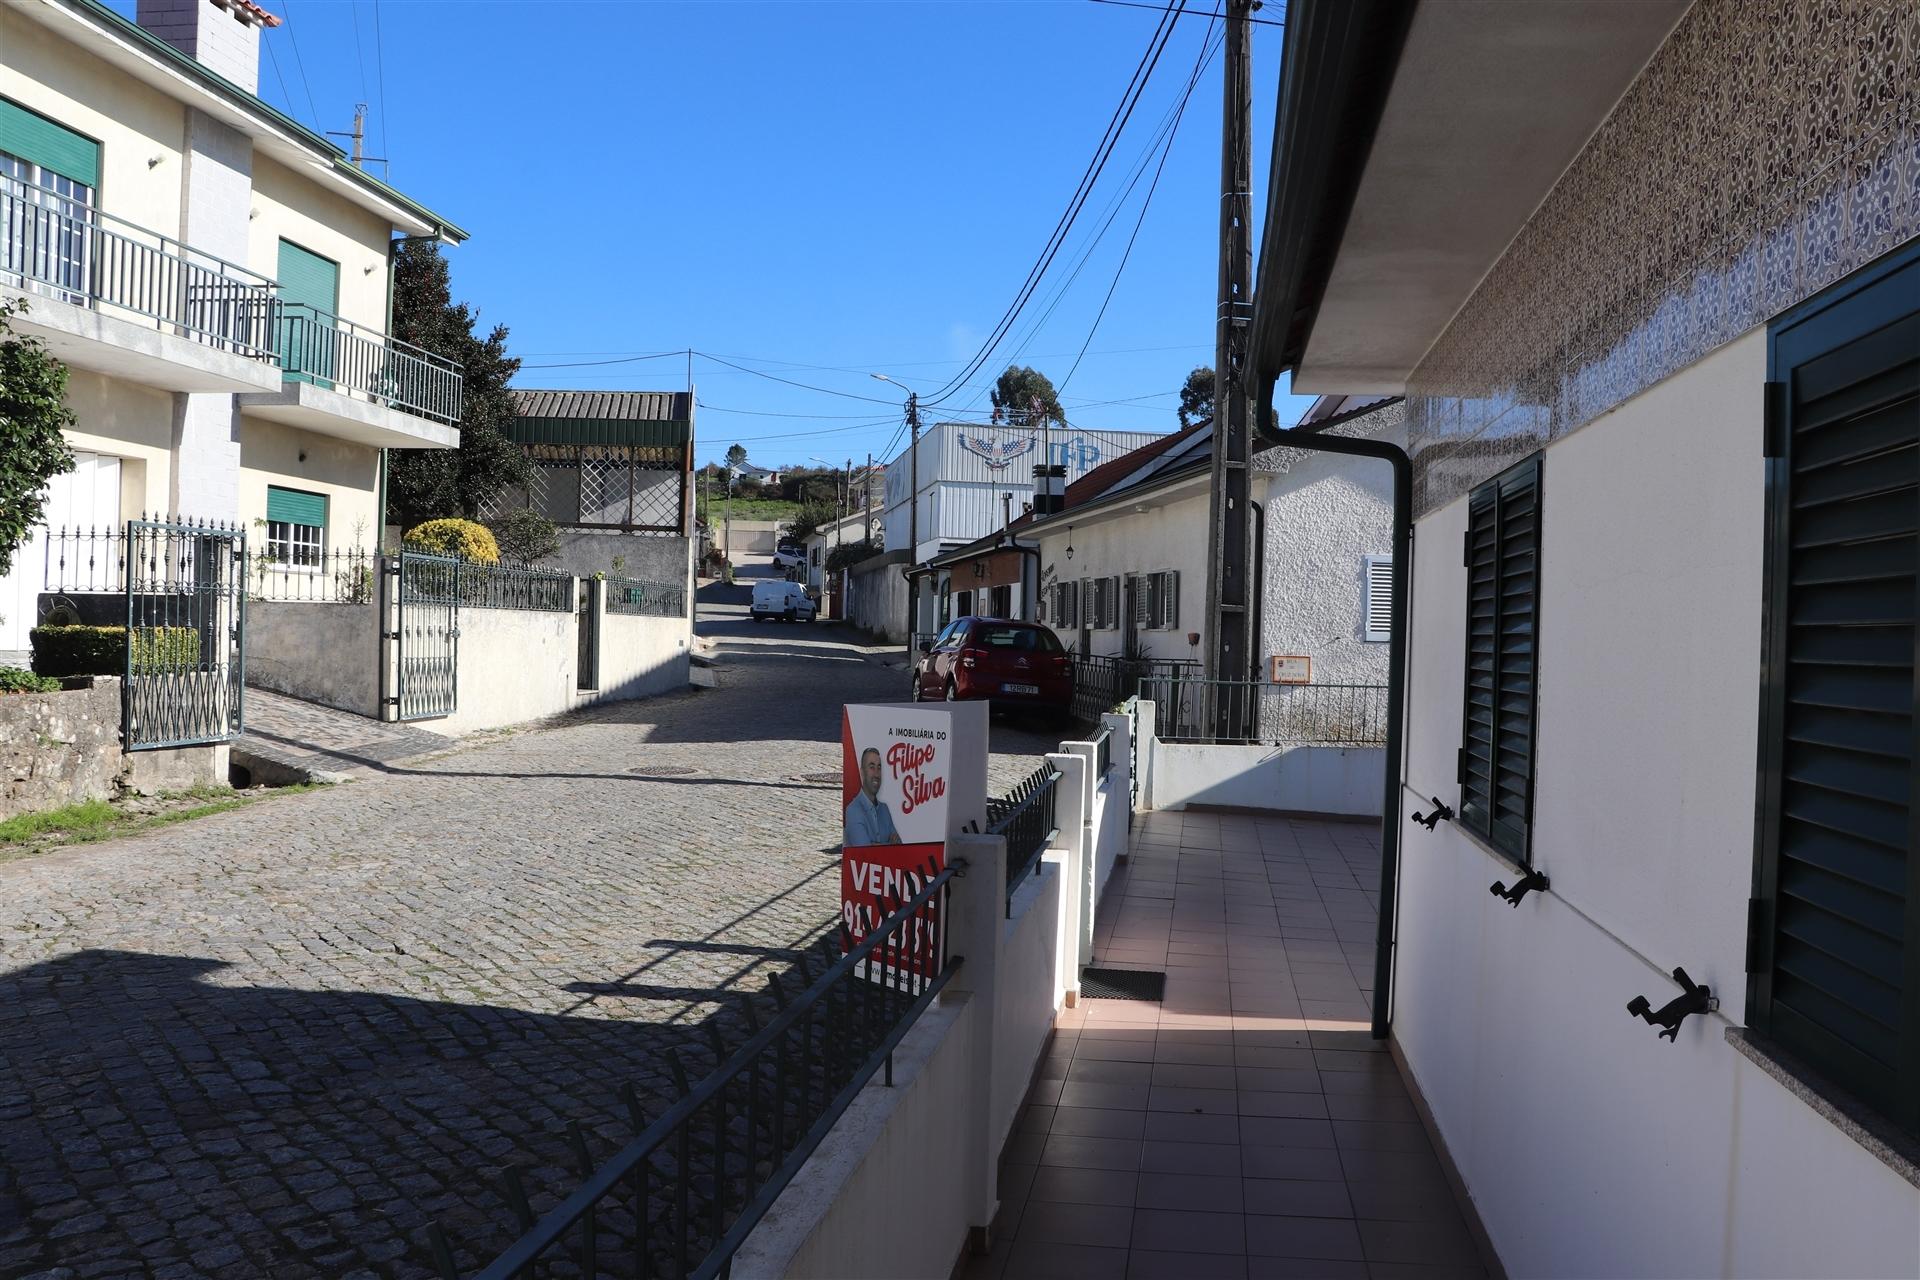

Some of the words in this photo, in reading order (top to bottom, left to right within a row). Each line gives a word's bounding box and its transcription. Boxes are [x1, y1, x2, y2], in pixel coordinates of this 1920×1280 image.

[888, 727, 893, 736] A
[895, 728, 934, 740] IMOBILIÁRIA
[936, 731, 947, 740] DO
[886, 742, 935, 780] Filipe
[902, 773, 946, 814] Silva
